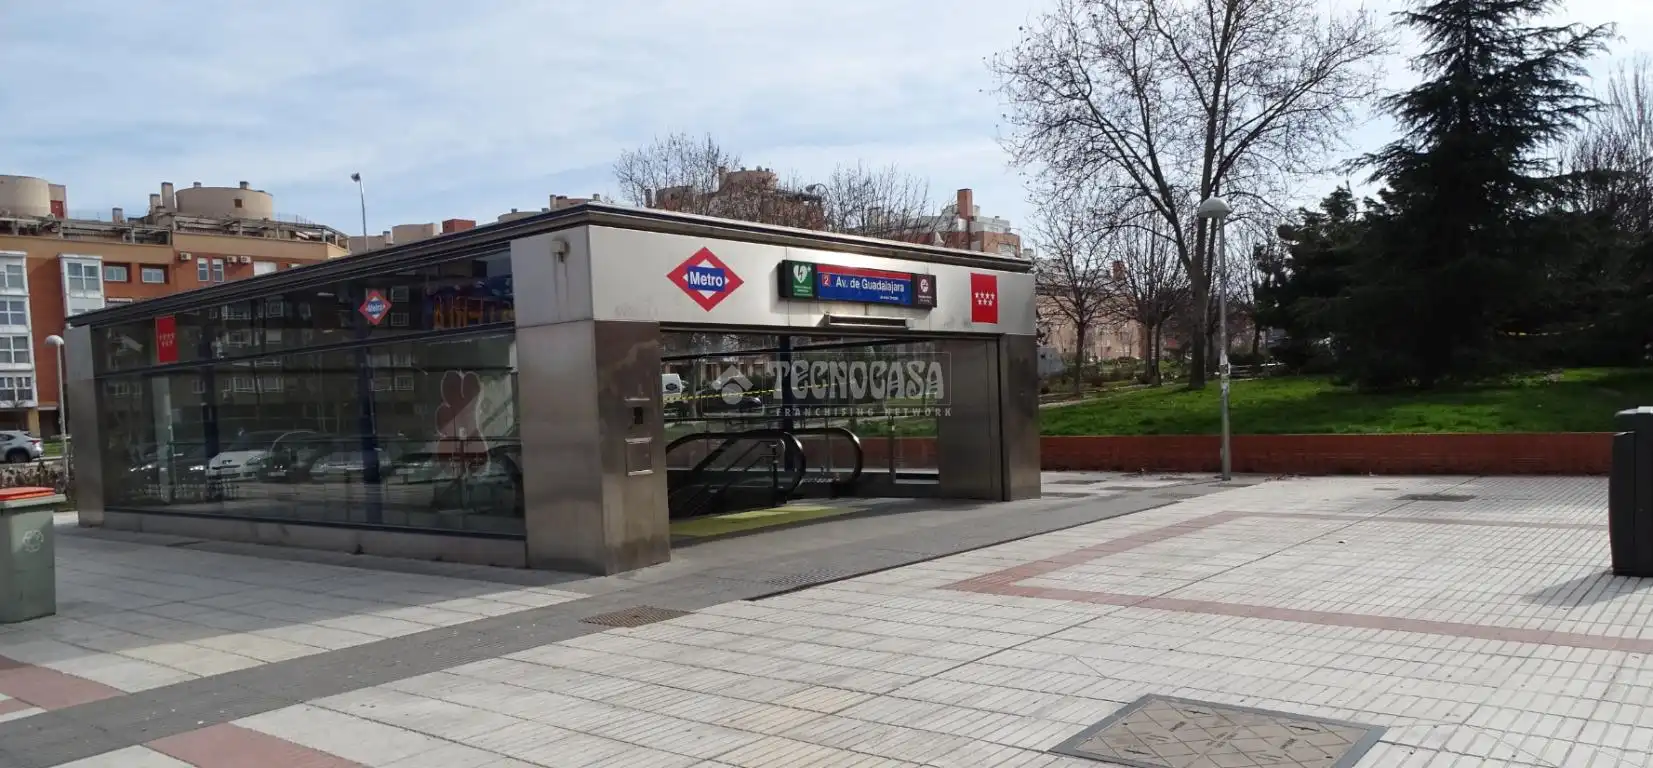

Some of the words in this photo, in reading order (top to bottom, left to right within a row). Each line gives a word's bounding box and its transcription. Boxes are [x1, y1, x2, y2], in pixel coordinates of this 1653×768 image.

[689, 271, 723, 287] Metro
[823, 275, 829, 285] 2
[836, 276, 848, 288] Av.
[850, 278, 860, 289] de
[861, 278, 905, 294] Guadalajara
